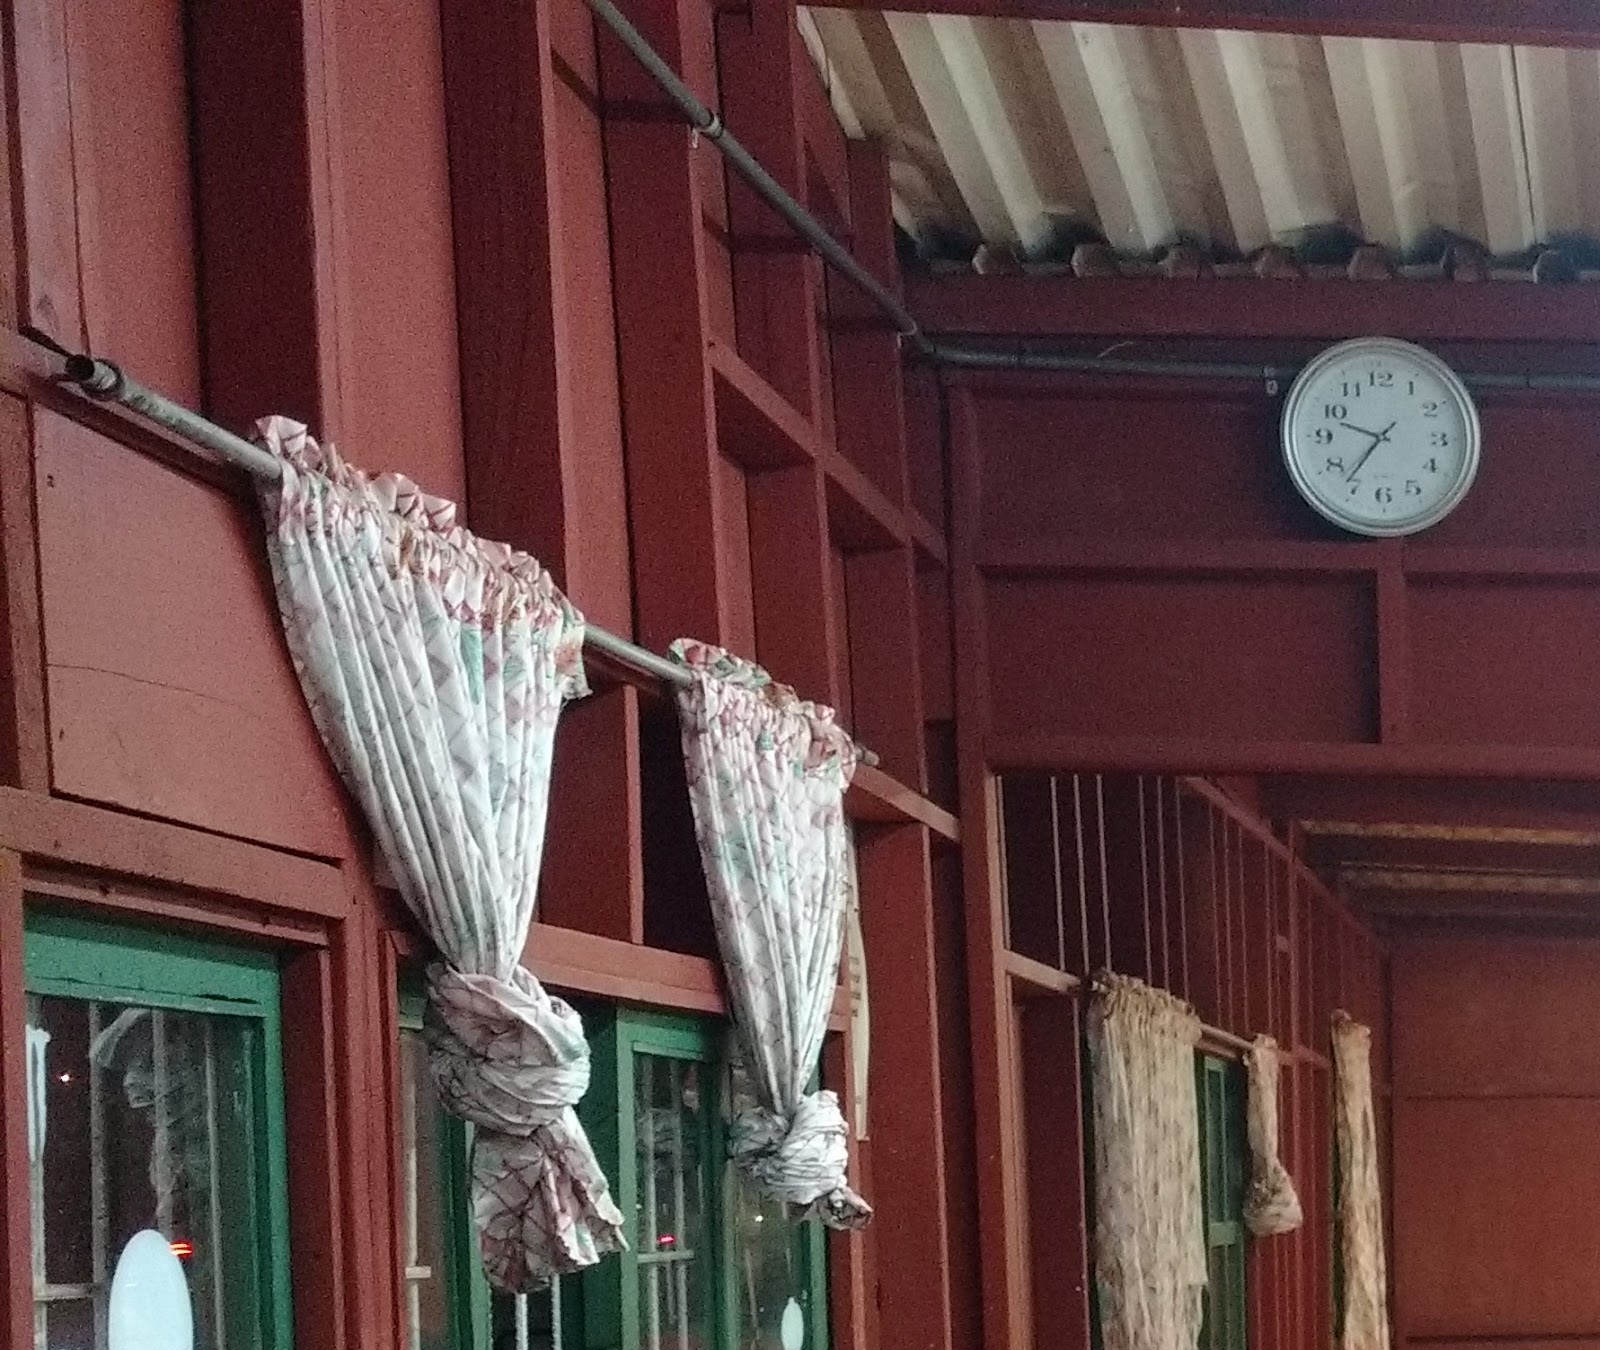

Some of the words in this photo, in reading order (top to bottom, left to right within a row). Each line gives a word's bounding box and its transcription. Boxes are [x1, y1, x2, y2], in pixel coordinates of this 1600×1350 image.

[1368, 370, 1394, 387] 12
[1341, 382, 1361, 397] 11
[1408, 380, 1415, 396] 1
[1324, 403, 1348, 420] 10
[1422, 402, 1438, 418] 2
[1315, 427, 1333, 445] 9
[1431, 431, 1448, 447] 3
[1326, 457, 1345, 473] 8
[1422, 457, 1437, 473] 4
[1349, 478, 1362, 496] 7
[1374, 486, 1393, 504] 6
[1404, 479, 1422, 496] 5
